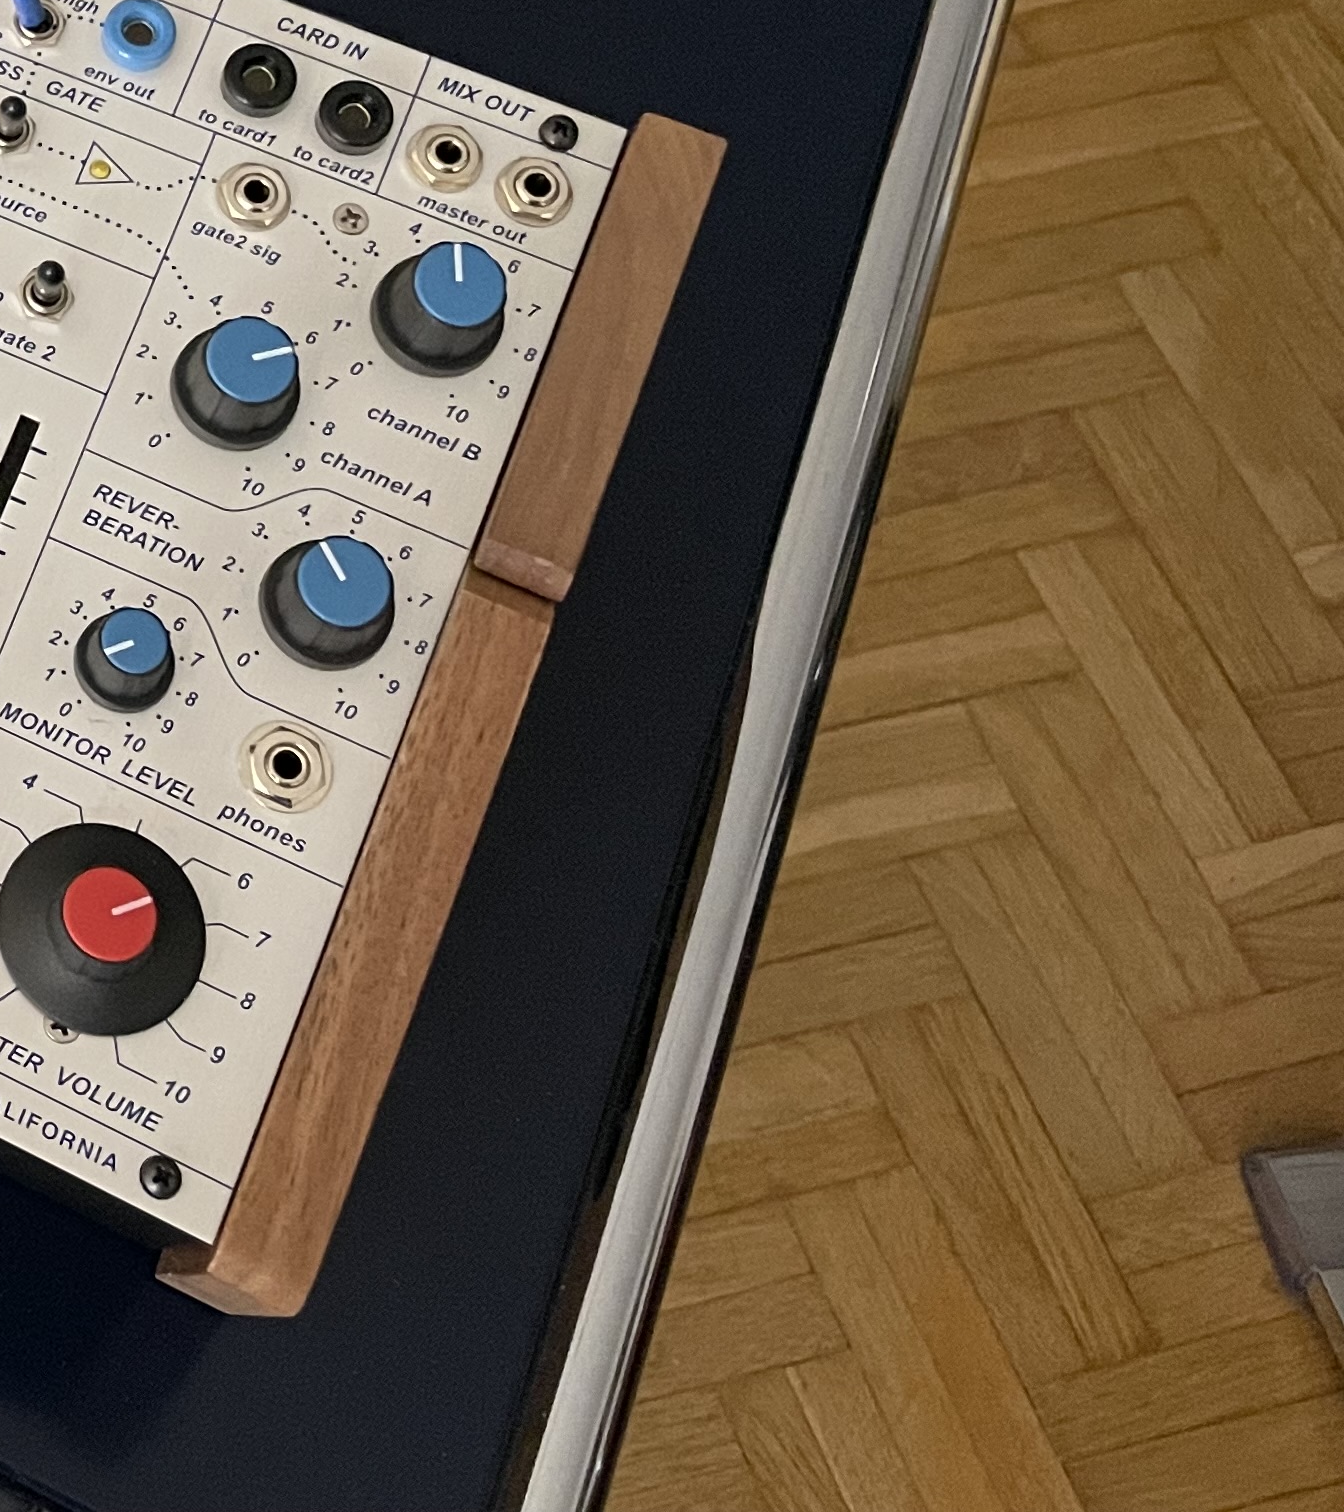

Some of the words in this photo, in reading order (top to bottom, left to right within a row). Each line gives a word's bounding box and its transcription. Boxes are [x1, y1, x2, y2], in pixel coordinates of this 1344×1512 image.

[276, 16, 341, 50] CARD
[344, 40, 371, 62] IN
[45, 79, 108, 114] GATE
[436, 76, 478, 104] MIX
[484, 96, 537, 123] OUT
[190, 218, 247, 250] gate2
[249, 237, 283, 267] sig
[416, 194, 490, 231] master
[491, 222, 529, 247] out
[366, 404, 461, 454] channel
[461, 440, 483, 464] B
[318, 446, 414, 500] channel
[412, 487, 436, 508] A
[92, 482, 181, 535] REVER-
[81, 508, 207, 575] BERATION
[119, 758, 197, 808] LEVEL
[216, 802, 308, 855] phones
[55, 1065, 165, 1134] VOLUME
